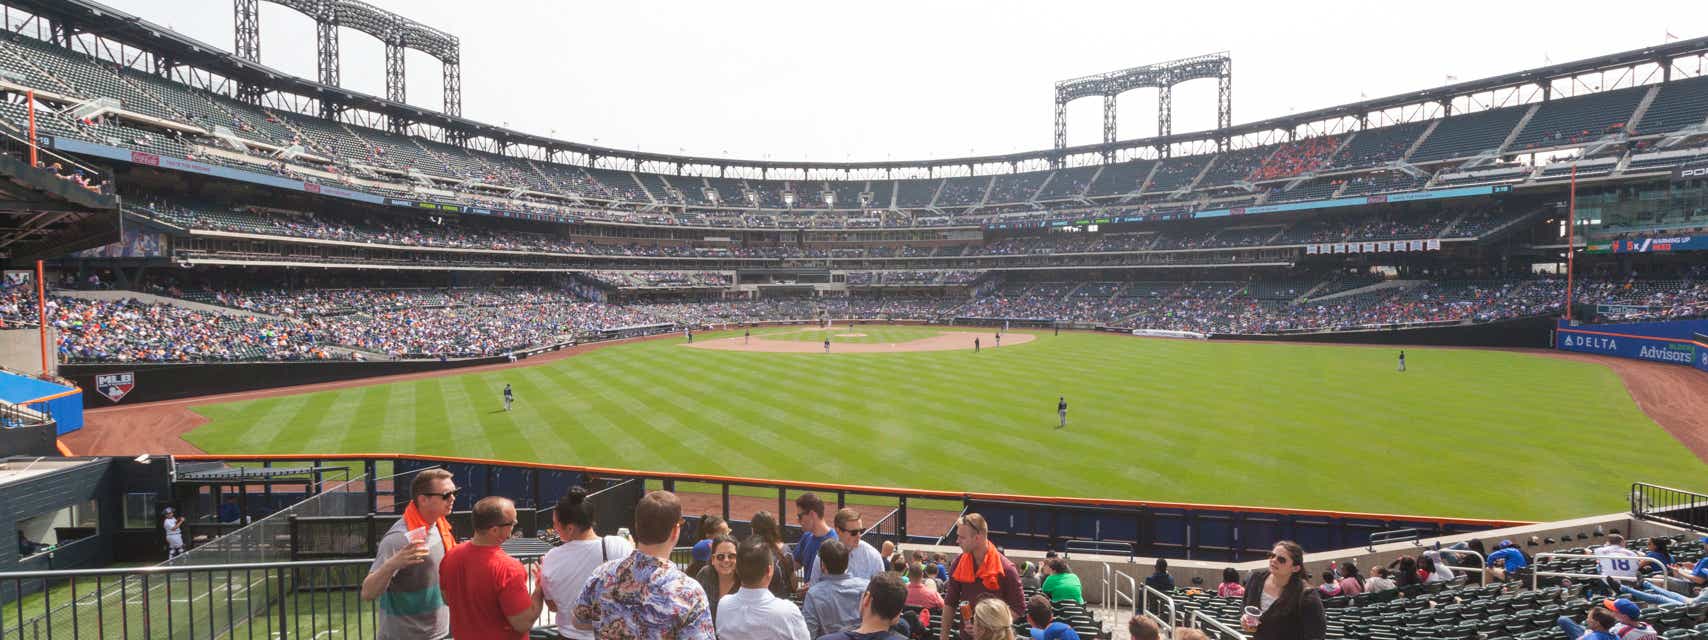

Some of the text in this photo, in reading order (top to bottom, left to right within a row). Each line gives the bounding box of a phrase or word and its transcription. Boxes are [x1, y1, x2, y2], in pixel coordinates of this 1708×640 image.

[1681, 168, 1708, 178] PO
[1575, 336, 1617, 350] DELTA
[1639, 345, 1692, 363] Advisors
[100, 374, 131, 387] MLB
[1612, 559, 1631, 571] 18
